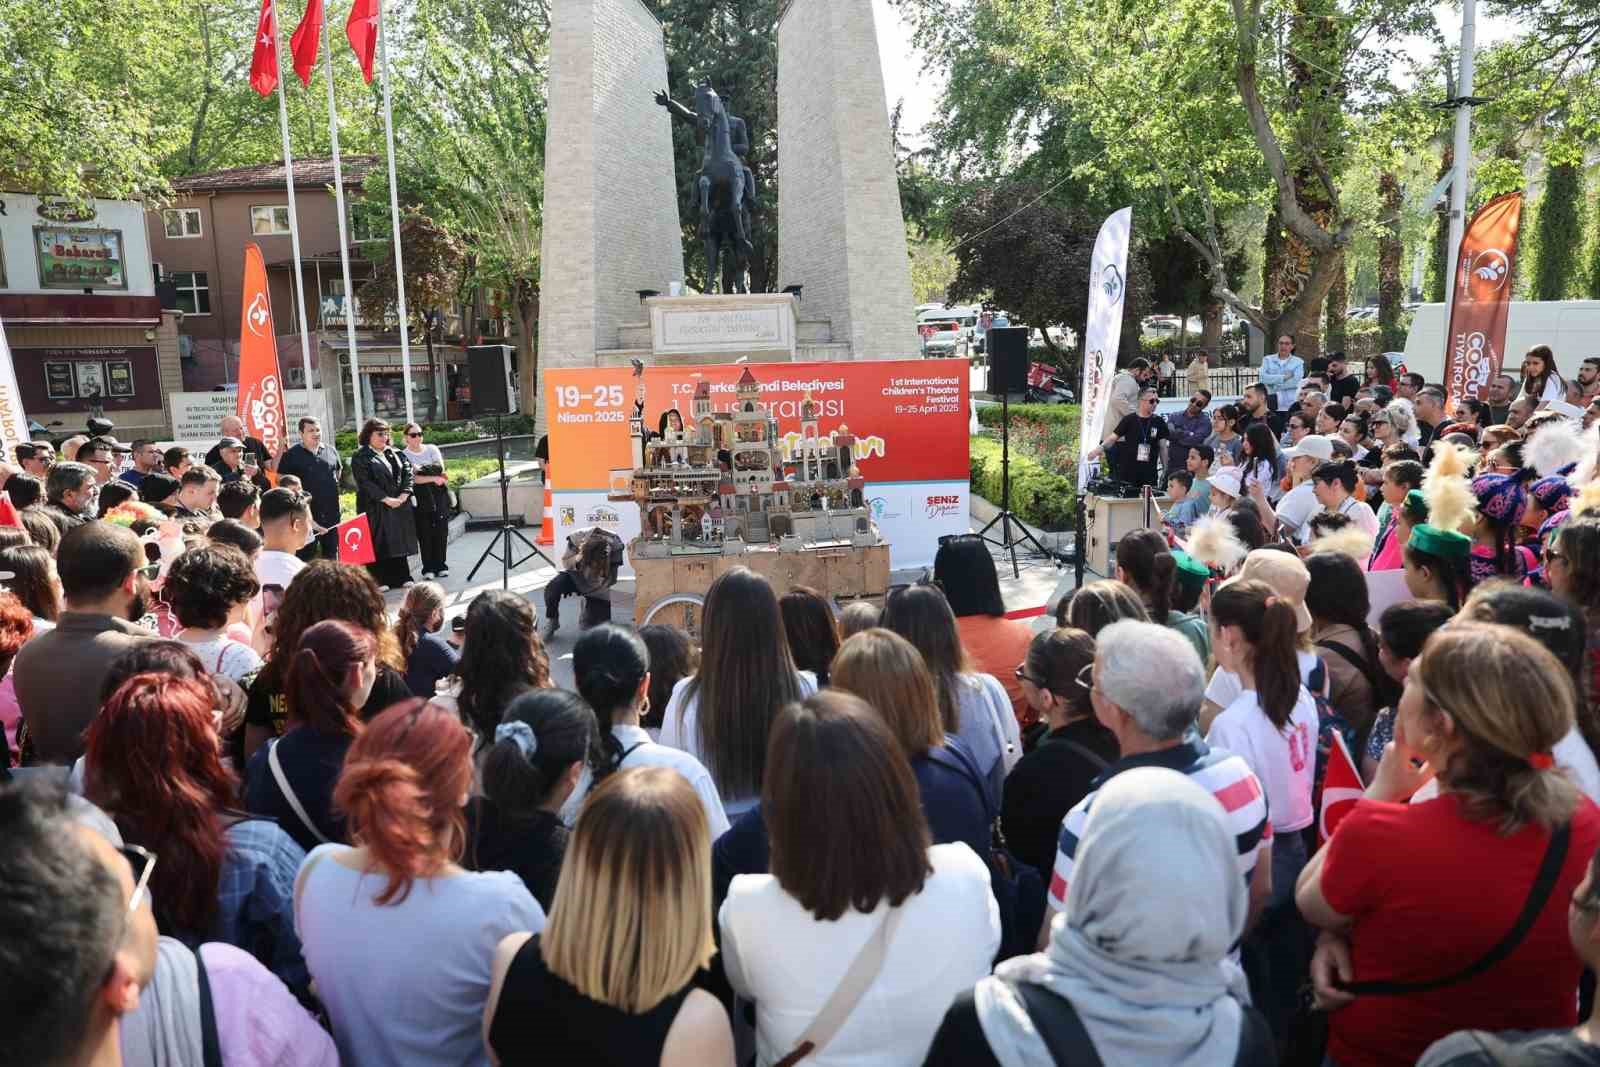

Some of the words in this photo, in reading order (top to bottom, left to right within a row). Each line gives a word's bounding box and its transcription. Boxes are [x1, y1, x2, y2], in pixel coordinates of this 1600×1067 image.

[782, 377, 844, 394] Belediyesi
[904, 376, 959, 386] International
[881, 386, 925, 396] Children's
[926, 386, 959, 395] Theatre
[926, 395, 959, 403] Festival
[919, 404, 938, 415] April
[938, 404, 959, 413] 2025
[558, 411, 592, 423] Nisan
[594, 411, 624, 423] 2025
